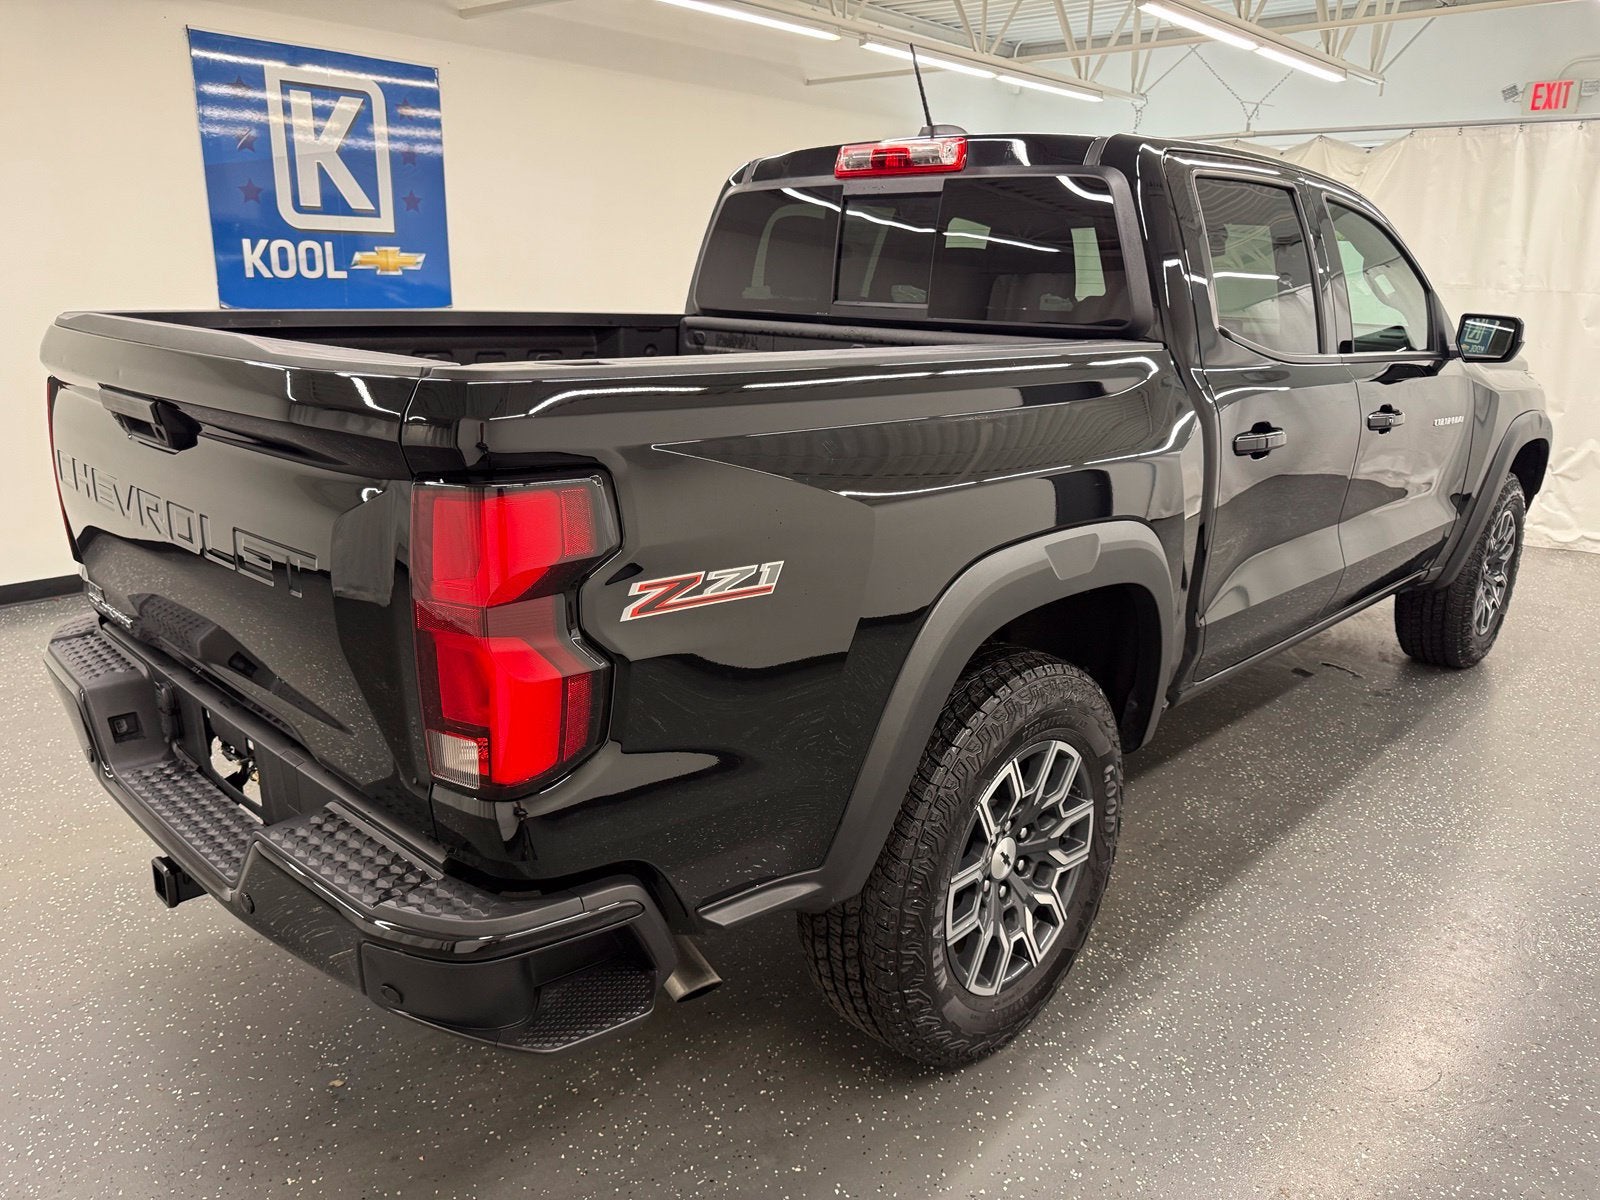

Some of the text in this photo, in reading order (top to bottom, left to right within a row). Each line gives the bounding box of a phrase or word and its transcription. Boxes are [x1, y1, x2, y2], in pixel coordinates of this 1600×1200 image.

[1530, 80, 1574, 111] EXIT
[289, 89, 375, 210] K
[241, 238, 348, 279] KOOL
[57, 449, 318, 599] CHEVROLET
[619, 560, 785, 623] Z71
